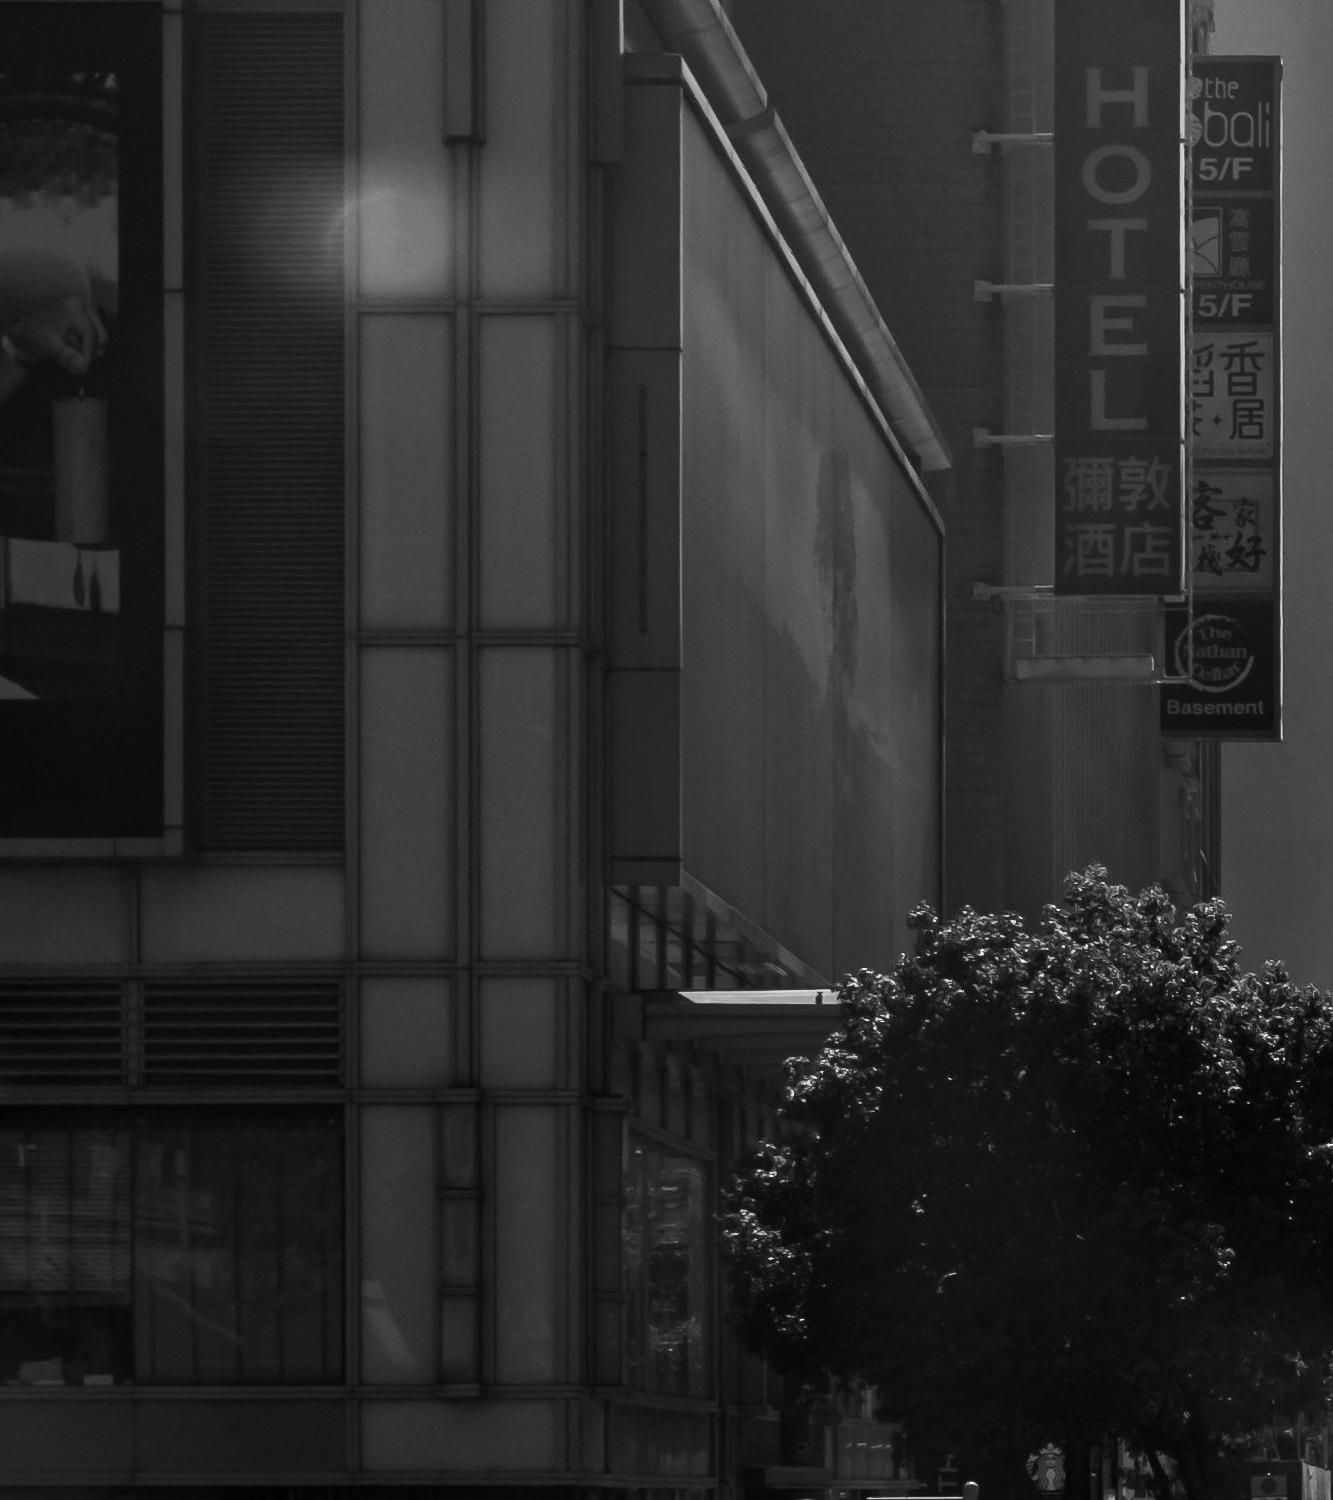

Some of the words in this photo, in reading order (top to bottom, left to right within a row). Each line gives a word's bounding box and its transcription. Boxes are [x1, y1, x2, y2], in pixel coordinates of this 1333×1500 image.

[1205, 77, 1240, 100] the
[1203, 101, 1271, 149] bali
[1198, 155, 1255, 182] 5/F
[1080, 66, 1153, 431] HOTEL
[1198, 293, 1255, 319] 5/F
[1197, 625, 1233, 641] The
[1166, 699, 1265, 716] Basement
